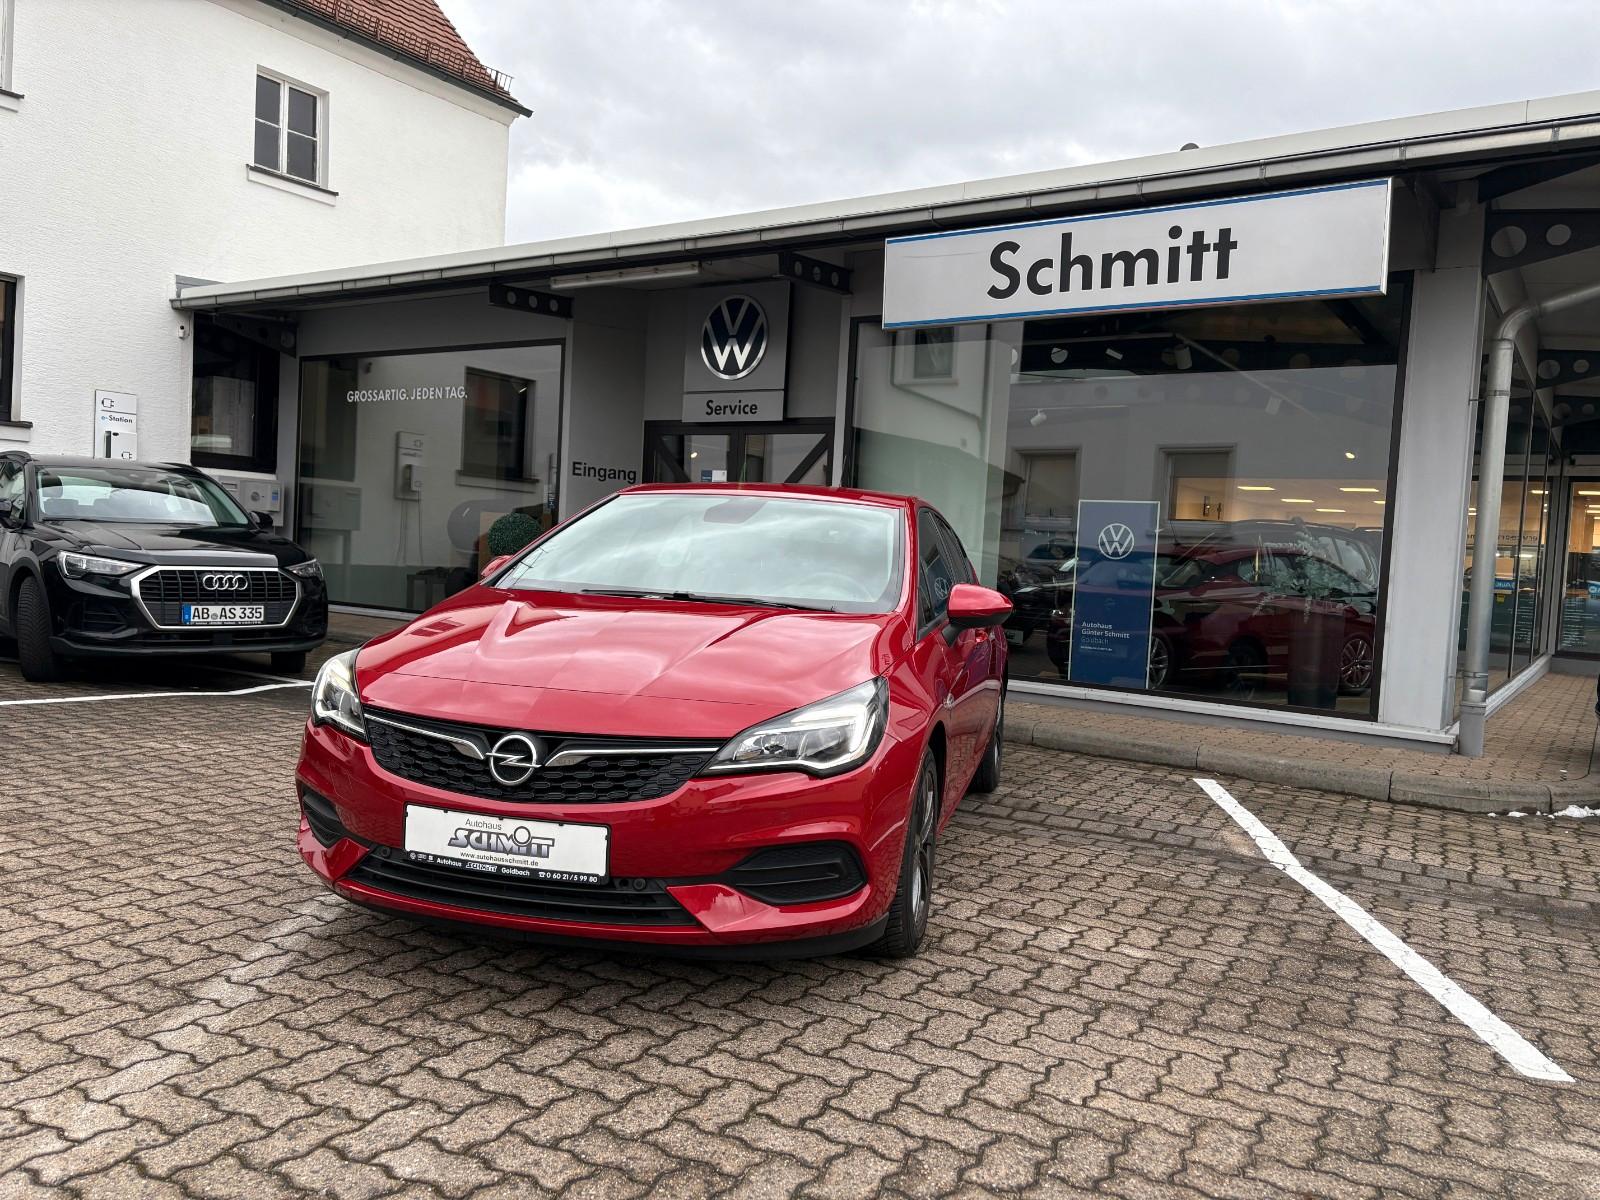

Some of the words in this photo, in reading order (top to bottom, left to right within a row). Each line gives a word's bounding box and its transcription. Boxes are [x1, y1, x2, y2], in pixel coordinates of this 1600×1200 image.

[987, 225, 1238, 300] Schmitt
[346, 388, 409, 403] GROSSARTIG.
[411, 386, 443, 400] JEDEN
[445, 386, 468, 399] TAG.
[705, 399, 758, 416] Service
[572, 461, 637, 484] Eingang
[192, 607, 210, 620] AB
[219, 607, 236, 620] AS
[239, 607, 263, 620] 335
[1081, 621, 1113, 630] Autohaus
[1081, 628, 1103, 636] Günter
[1104, 631, 1130, 639] Schmitt
[465, 818, 502, 831] Autohaus
[436, 857, 462, 867] Autohaus
[501, 867, 530, 876] Goldbach
[460, 851, 539, 867] www.autohausschmitt.de
